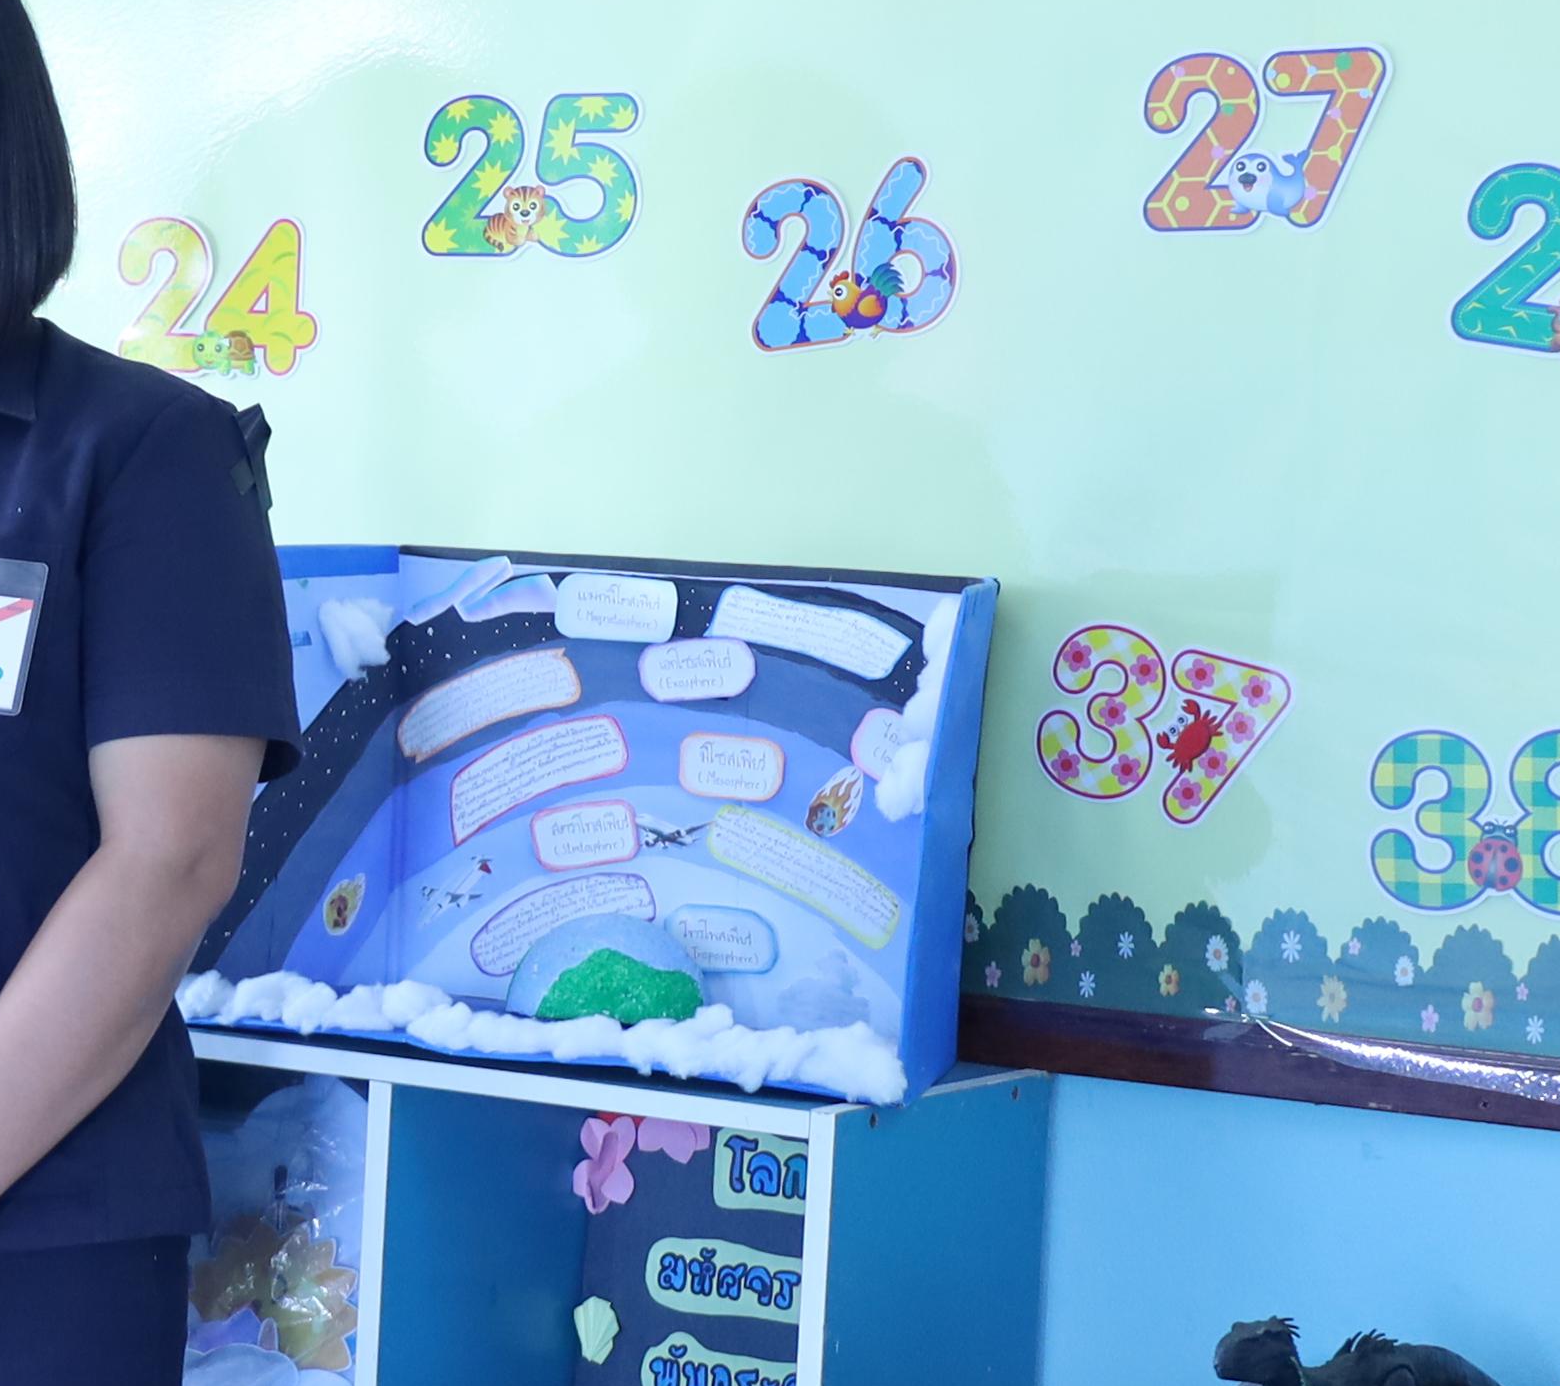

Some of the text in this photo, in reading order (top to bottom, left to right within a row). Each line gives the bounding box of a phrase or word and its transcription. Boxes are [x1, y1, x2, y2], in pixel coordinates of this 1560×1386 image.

[422, 92, 640, 257] 25
[1143, 46, 1386, 232] 27
[117, 217, 319, 375] 24
[741, 155, 958, 352] 26
[659, 675, 724, 689] (Exosphere)
[1036, 625, 1292, 826] 37
[698, 771, 767, 791] (Mesosphere)
